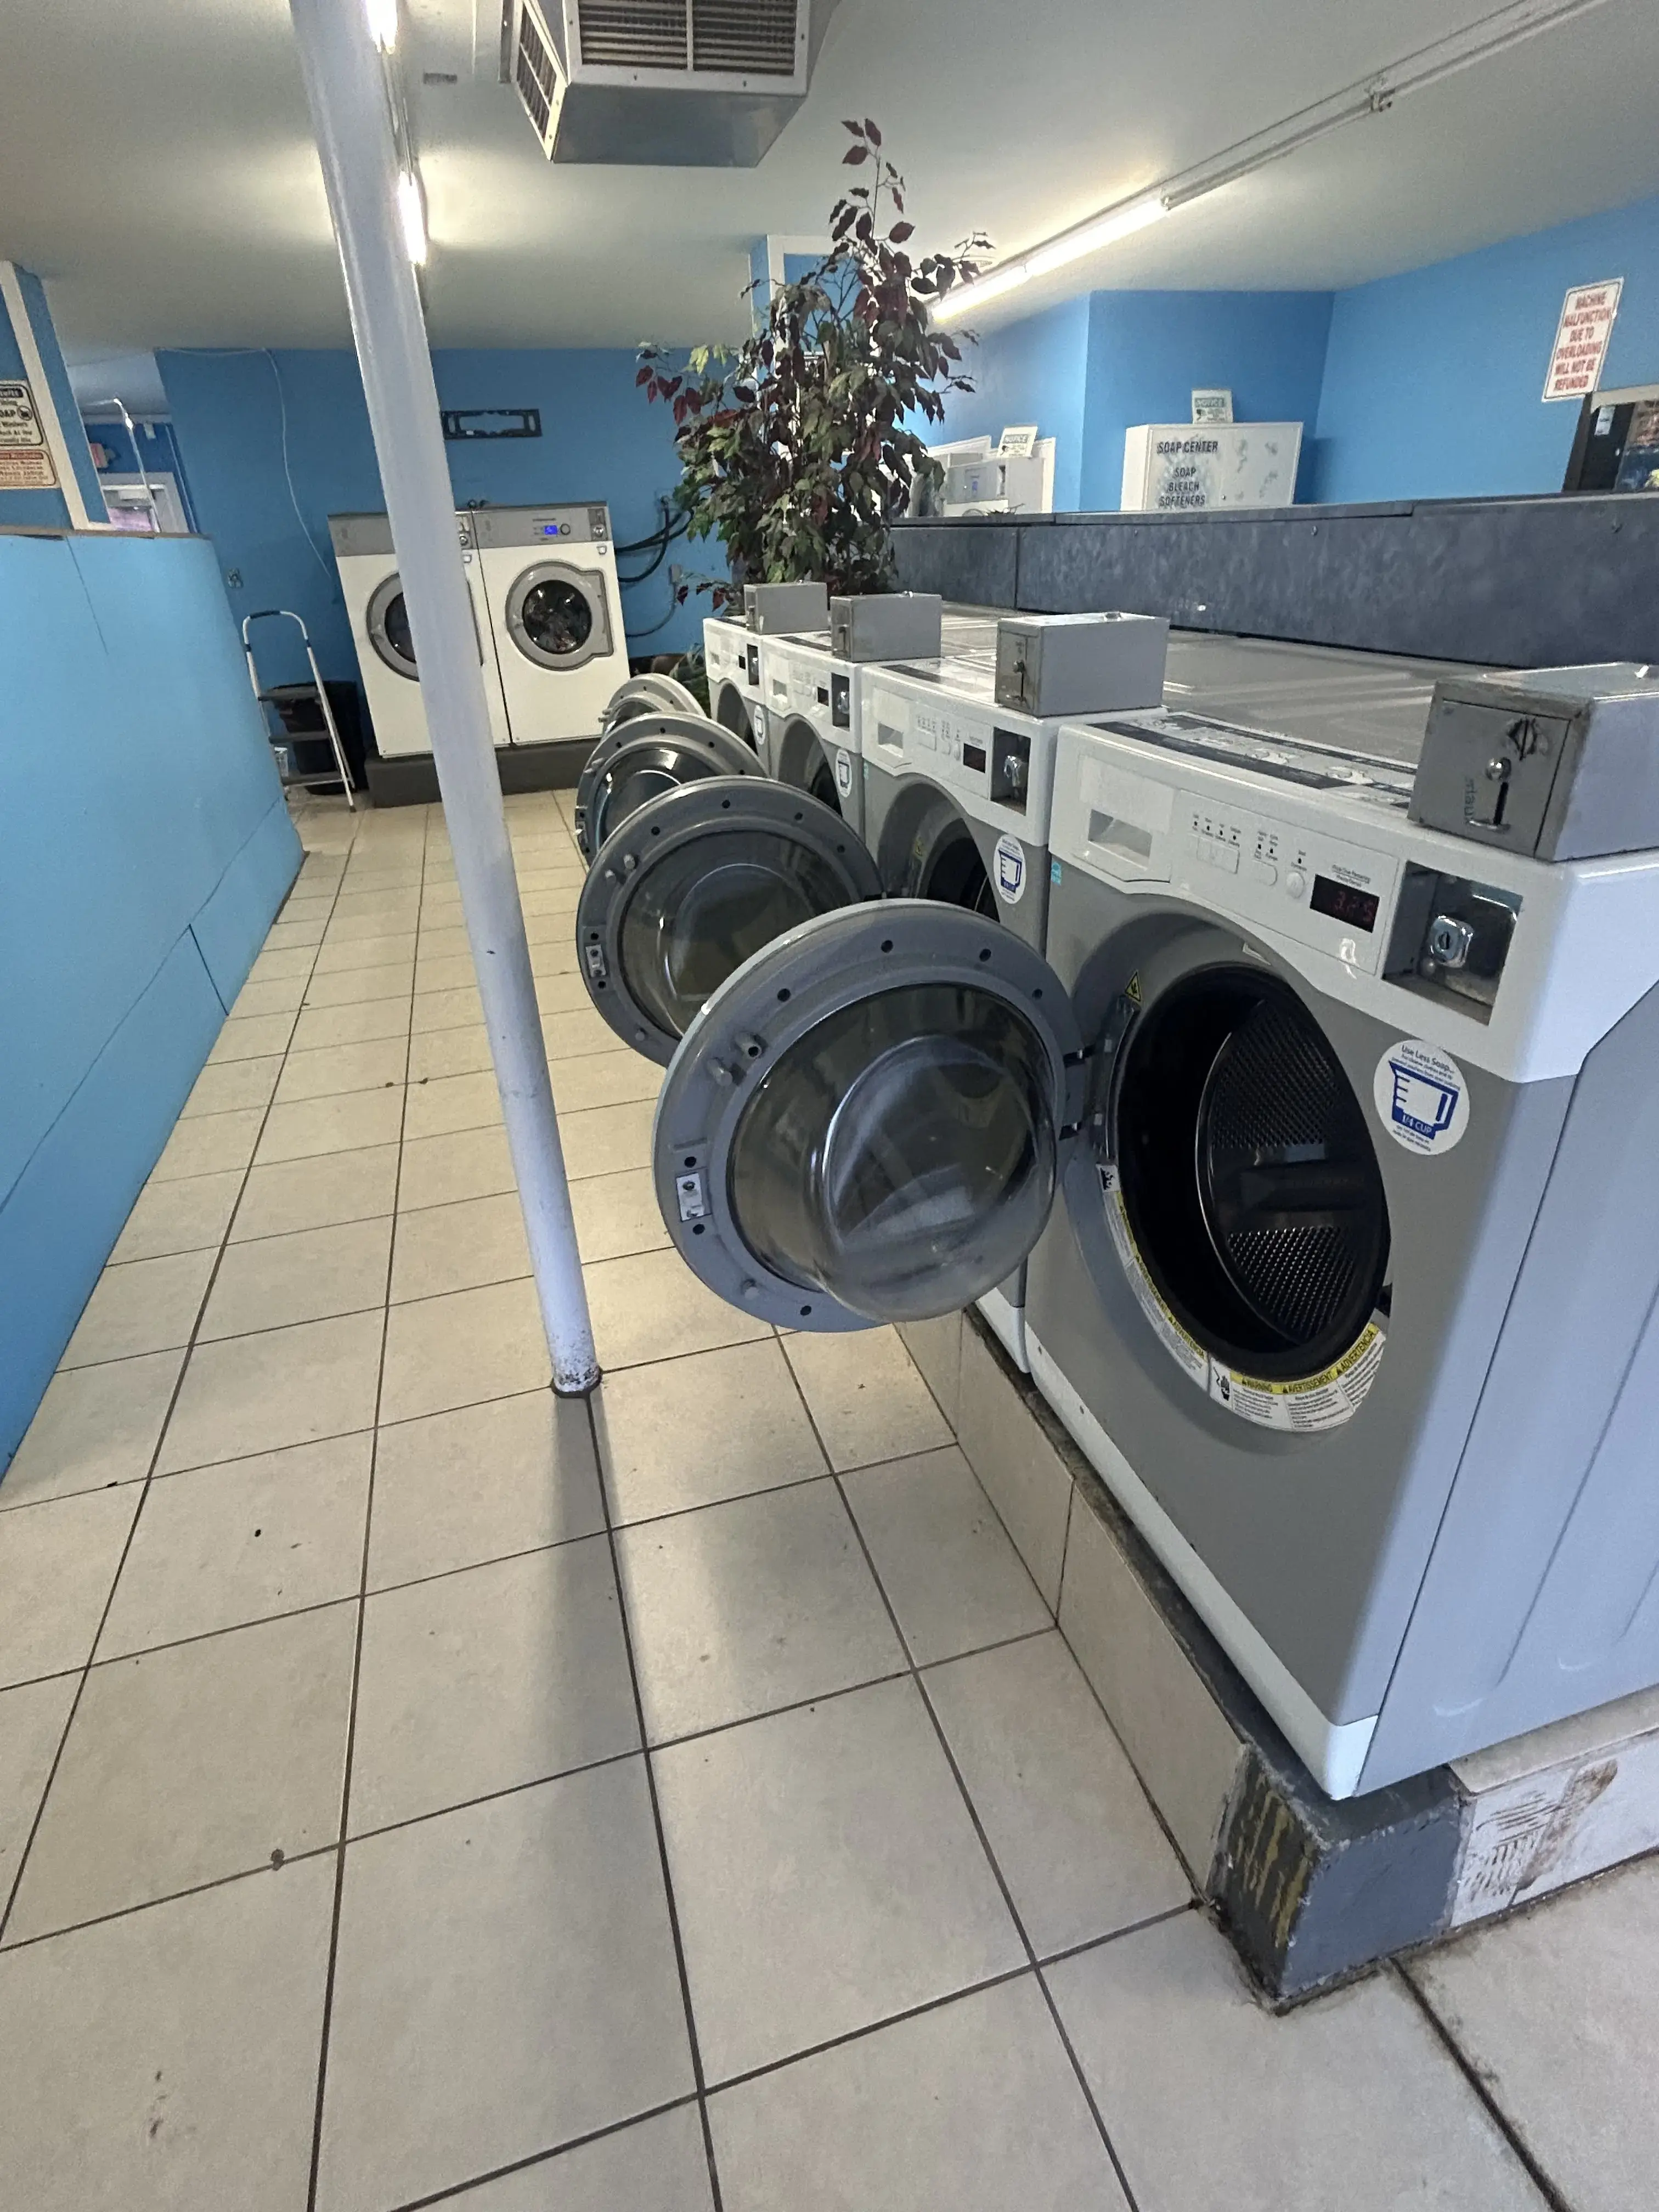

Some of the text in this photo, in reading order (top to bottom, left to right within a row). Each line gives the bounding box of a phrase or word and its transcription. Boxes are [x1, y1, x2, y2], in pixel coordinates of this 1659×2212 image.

[1156, 441, 1218, 454] SOAP CENTER
[1173, 466, 1196, 478] SOAP
[1167, 482, 1199, 492] BLEACH
[1159, 495, 1206, 507] SOFTENERS
[1402, 1045, 1414, 1055] Use
[1415, 1051, 1429, 1063] Less
[1415, 1121, 1432, 1134] CUP
[1340, 1329, 1375, 1372] ADVERTENCIA
